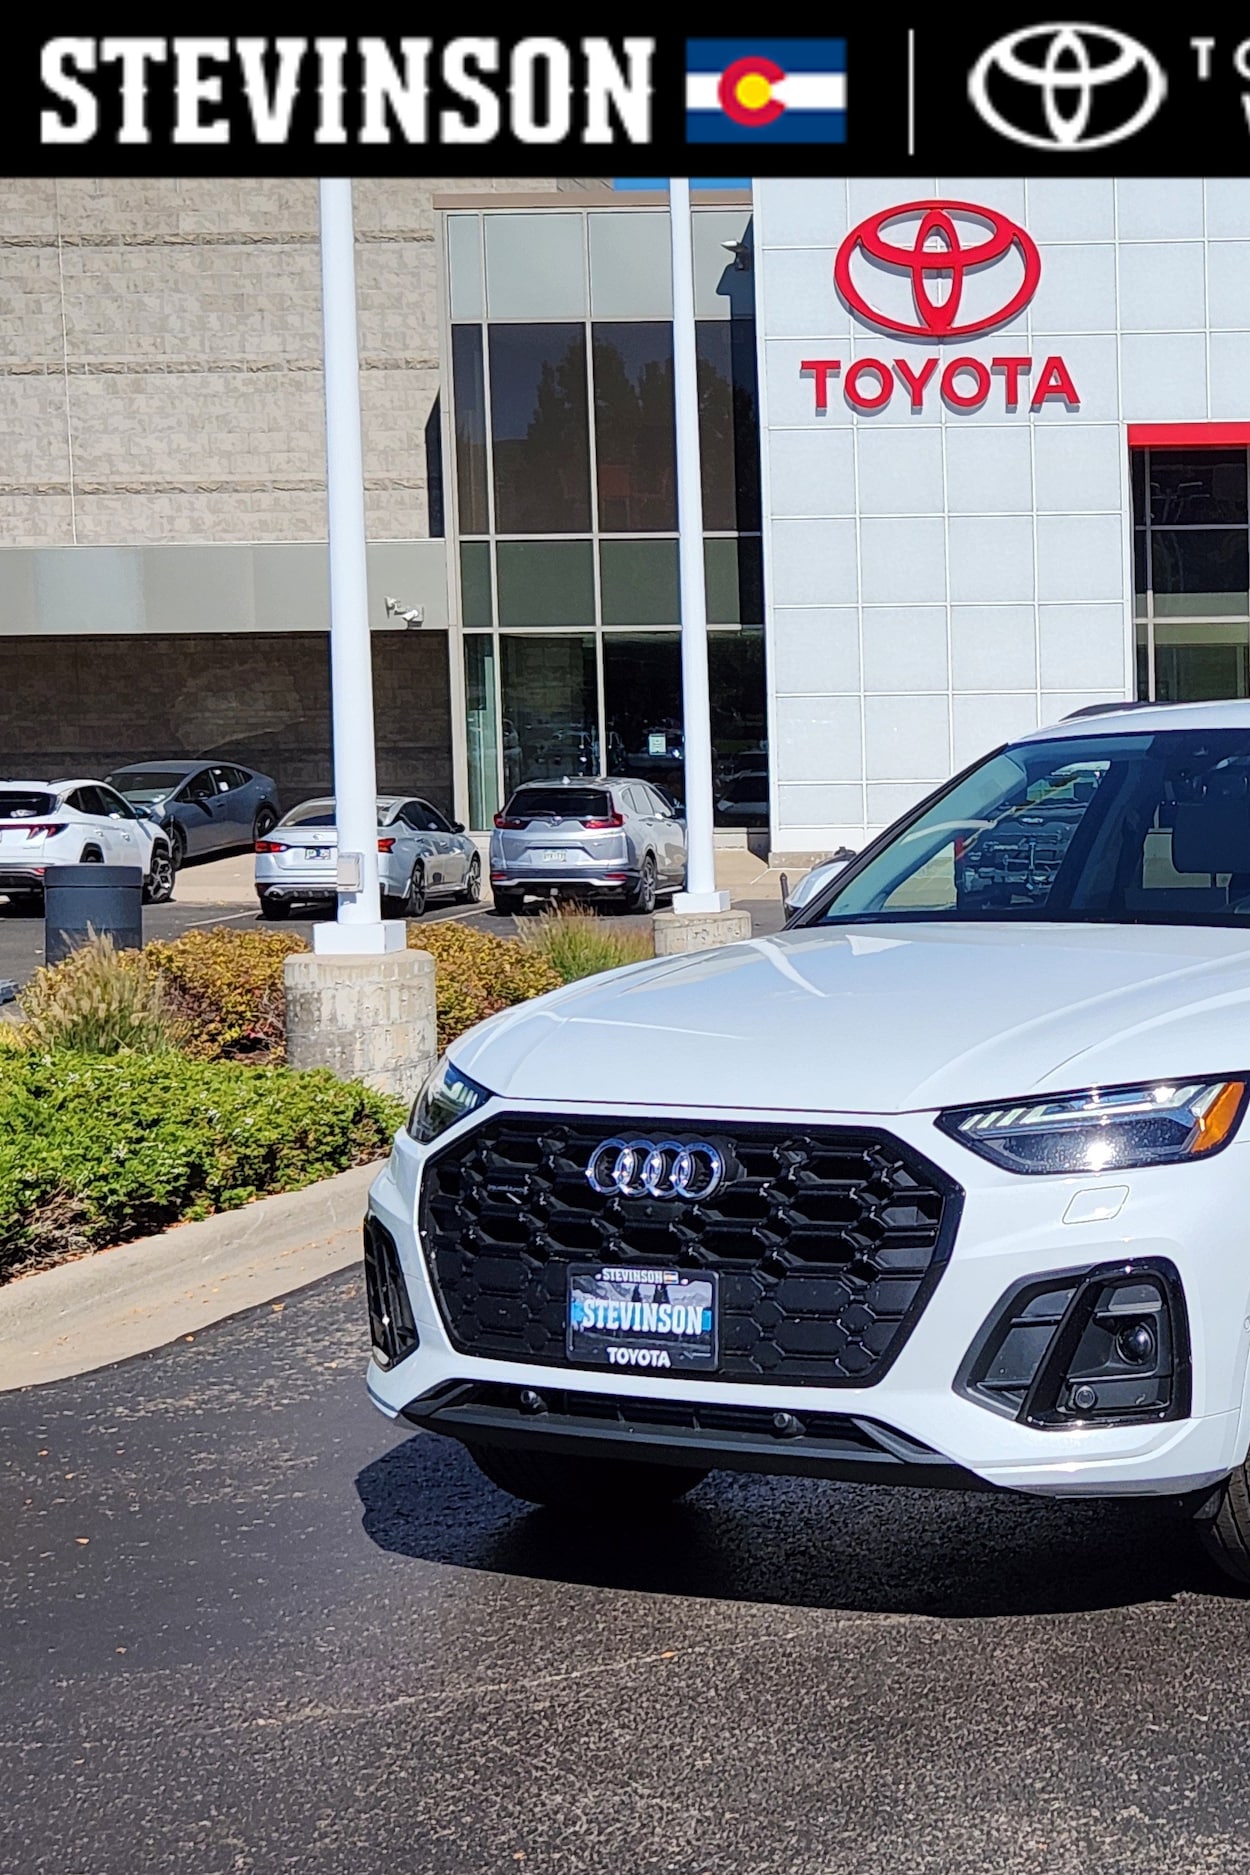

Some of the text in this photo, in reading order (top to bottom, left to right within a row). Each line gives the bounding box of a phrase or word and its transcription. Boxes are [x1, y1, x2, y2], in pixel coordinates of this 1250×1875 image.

[801, 356, 1080, 411] TOYOTA
[602, 1267, 664, 1284] STEVINSON
[583, 1300, 703, 1335] STEVINSON
[606, 1347, 672, 1368] TOYOTA
